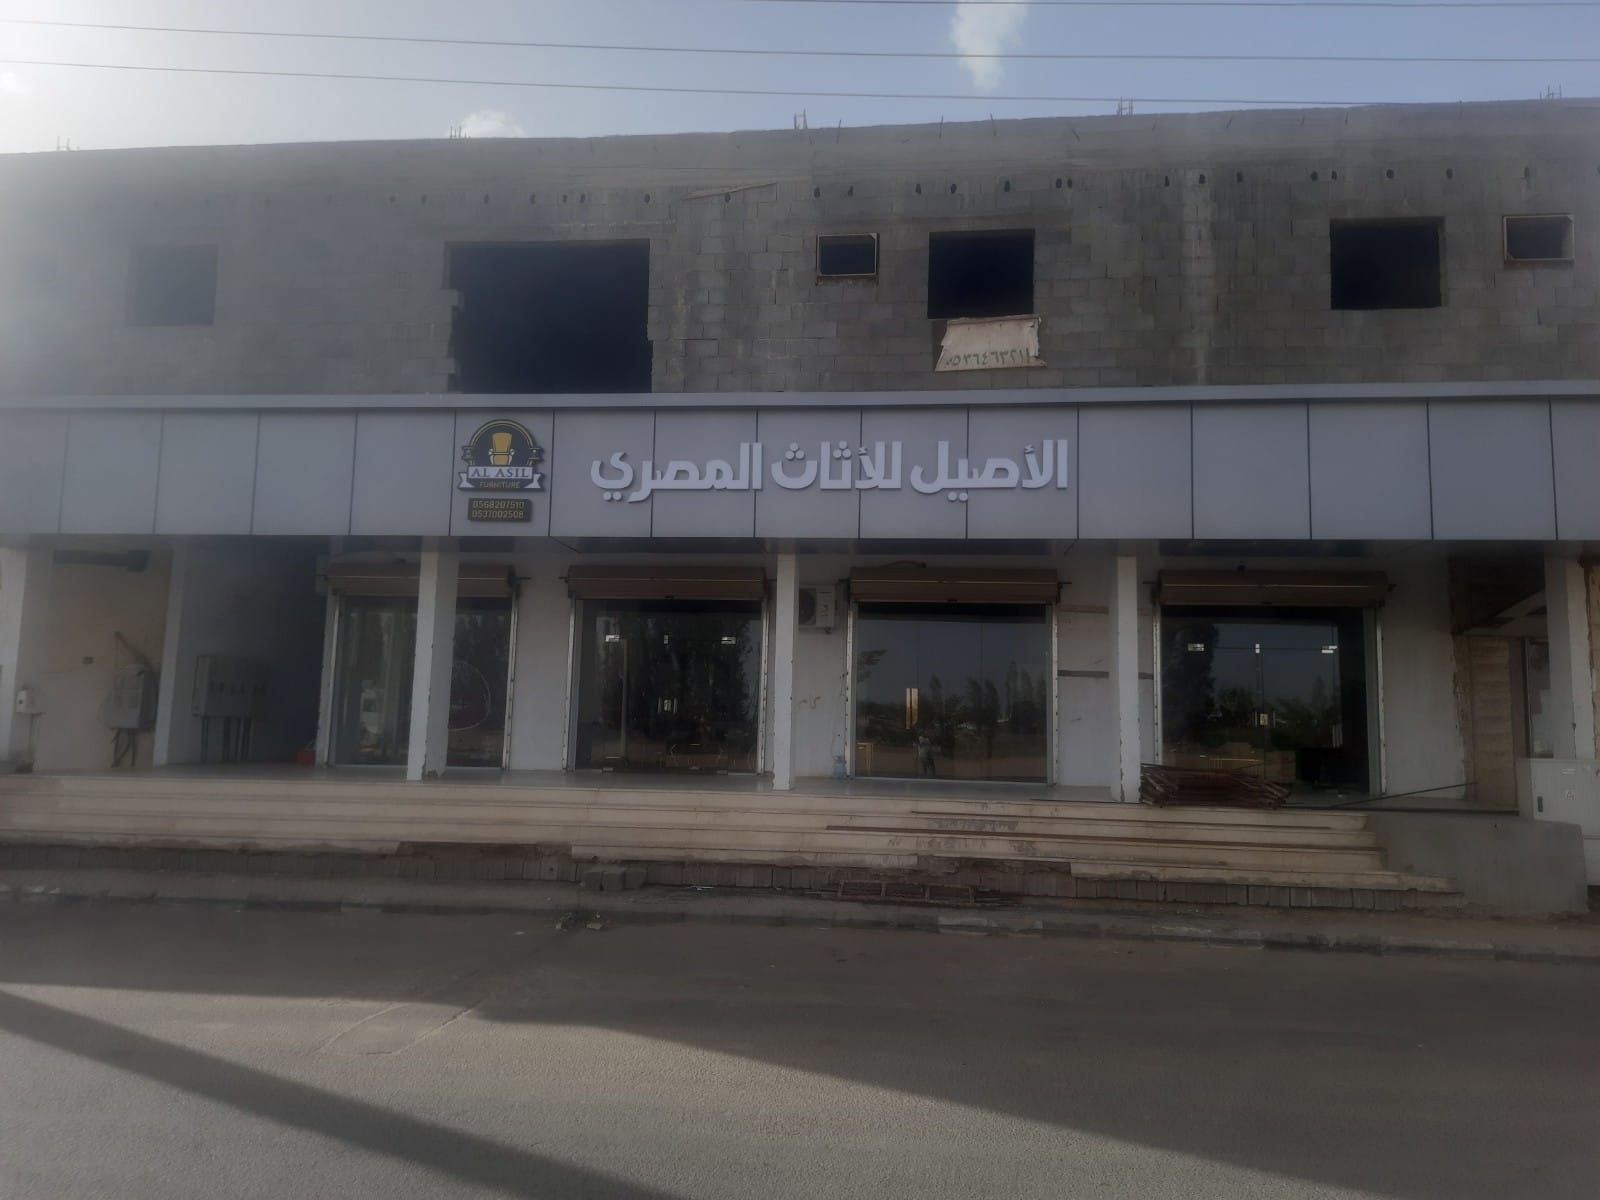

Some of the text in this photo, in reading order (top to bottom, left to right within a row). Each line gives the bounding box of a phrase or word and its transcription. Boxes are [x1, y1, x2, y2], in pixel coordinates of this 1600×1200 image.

[471, 467, 529, 478] AL ASIL
[590, 439, 1069, 504] الأصيل للأثاث المصري
[479, 481, 521, 489] FURNITURE
